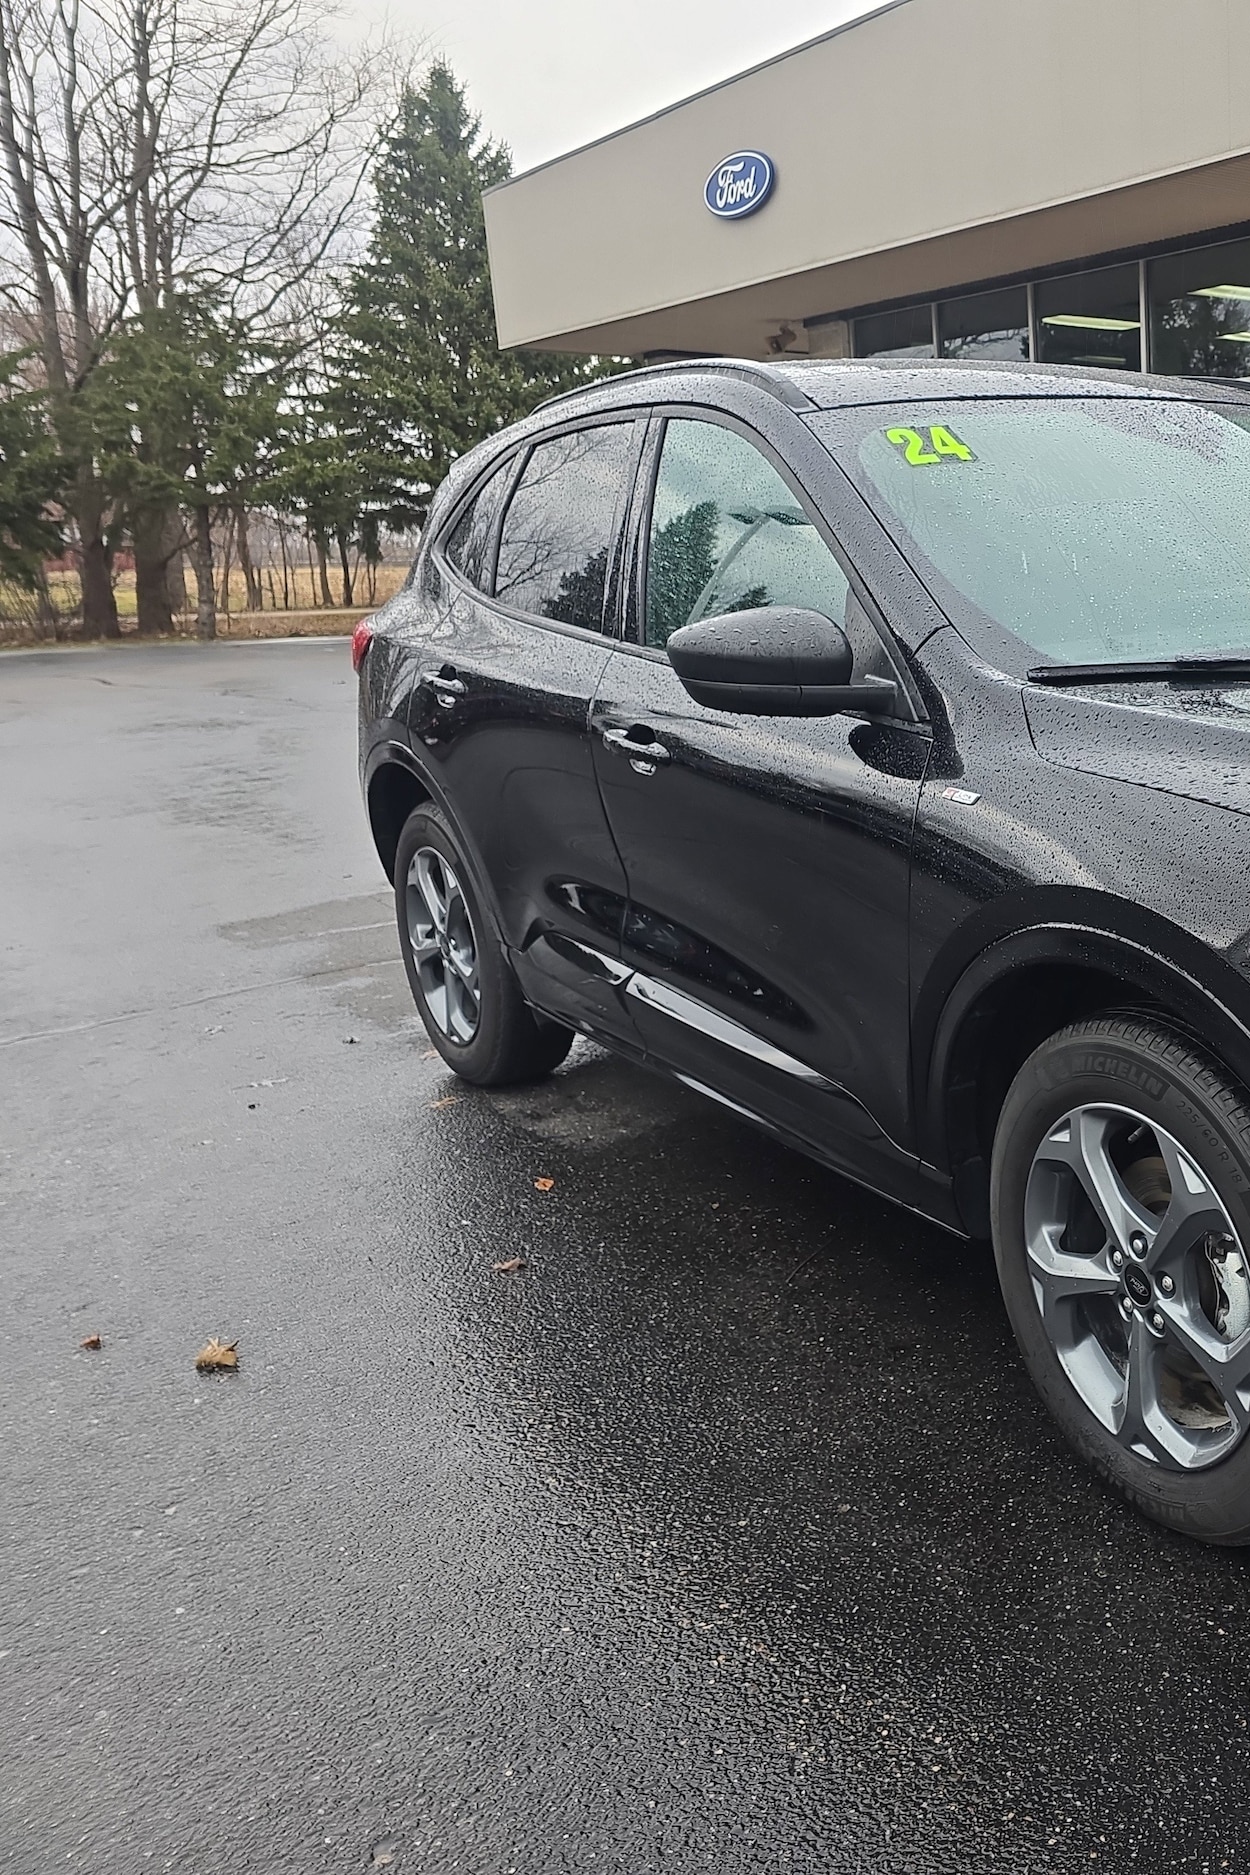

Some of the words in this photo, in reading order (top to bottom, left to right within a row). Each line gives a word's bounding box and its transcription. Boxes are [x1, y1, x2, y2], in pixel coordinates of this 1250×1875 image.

[716, 161, 757, 208] Ford
[886, 426, 974, 466] 24
[1071, 1055, 1163, 1096] MICHELIN
[1176, 1100, 1218, 1147] 225/60
[1229, 1167, 1242, 1184] 18
